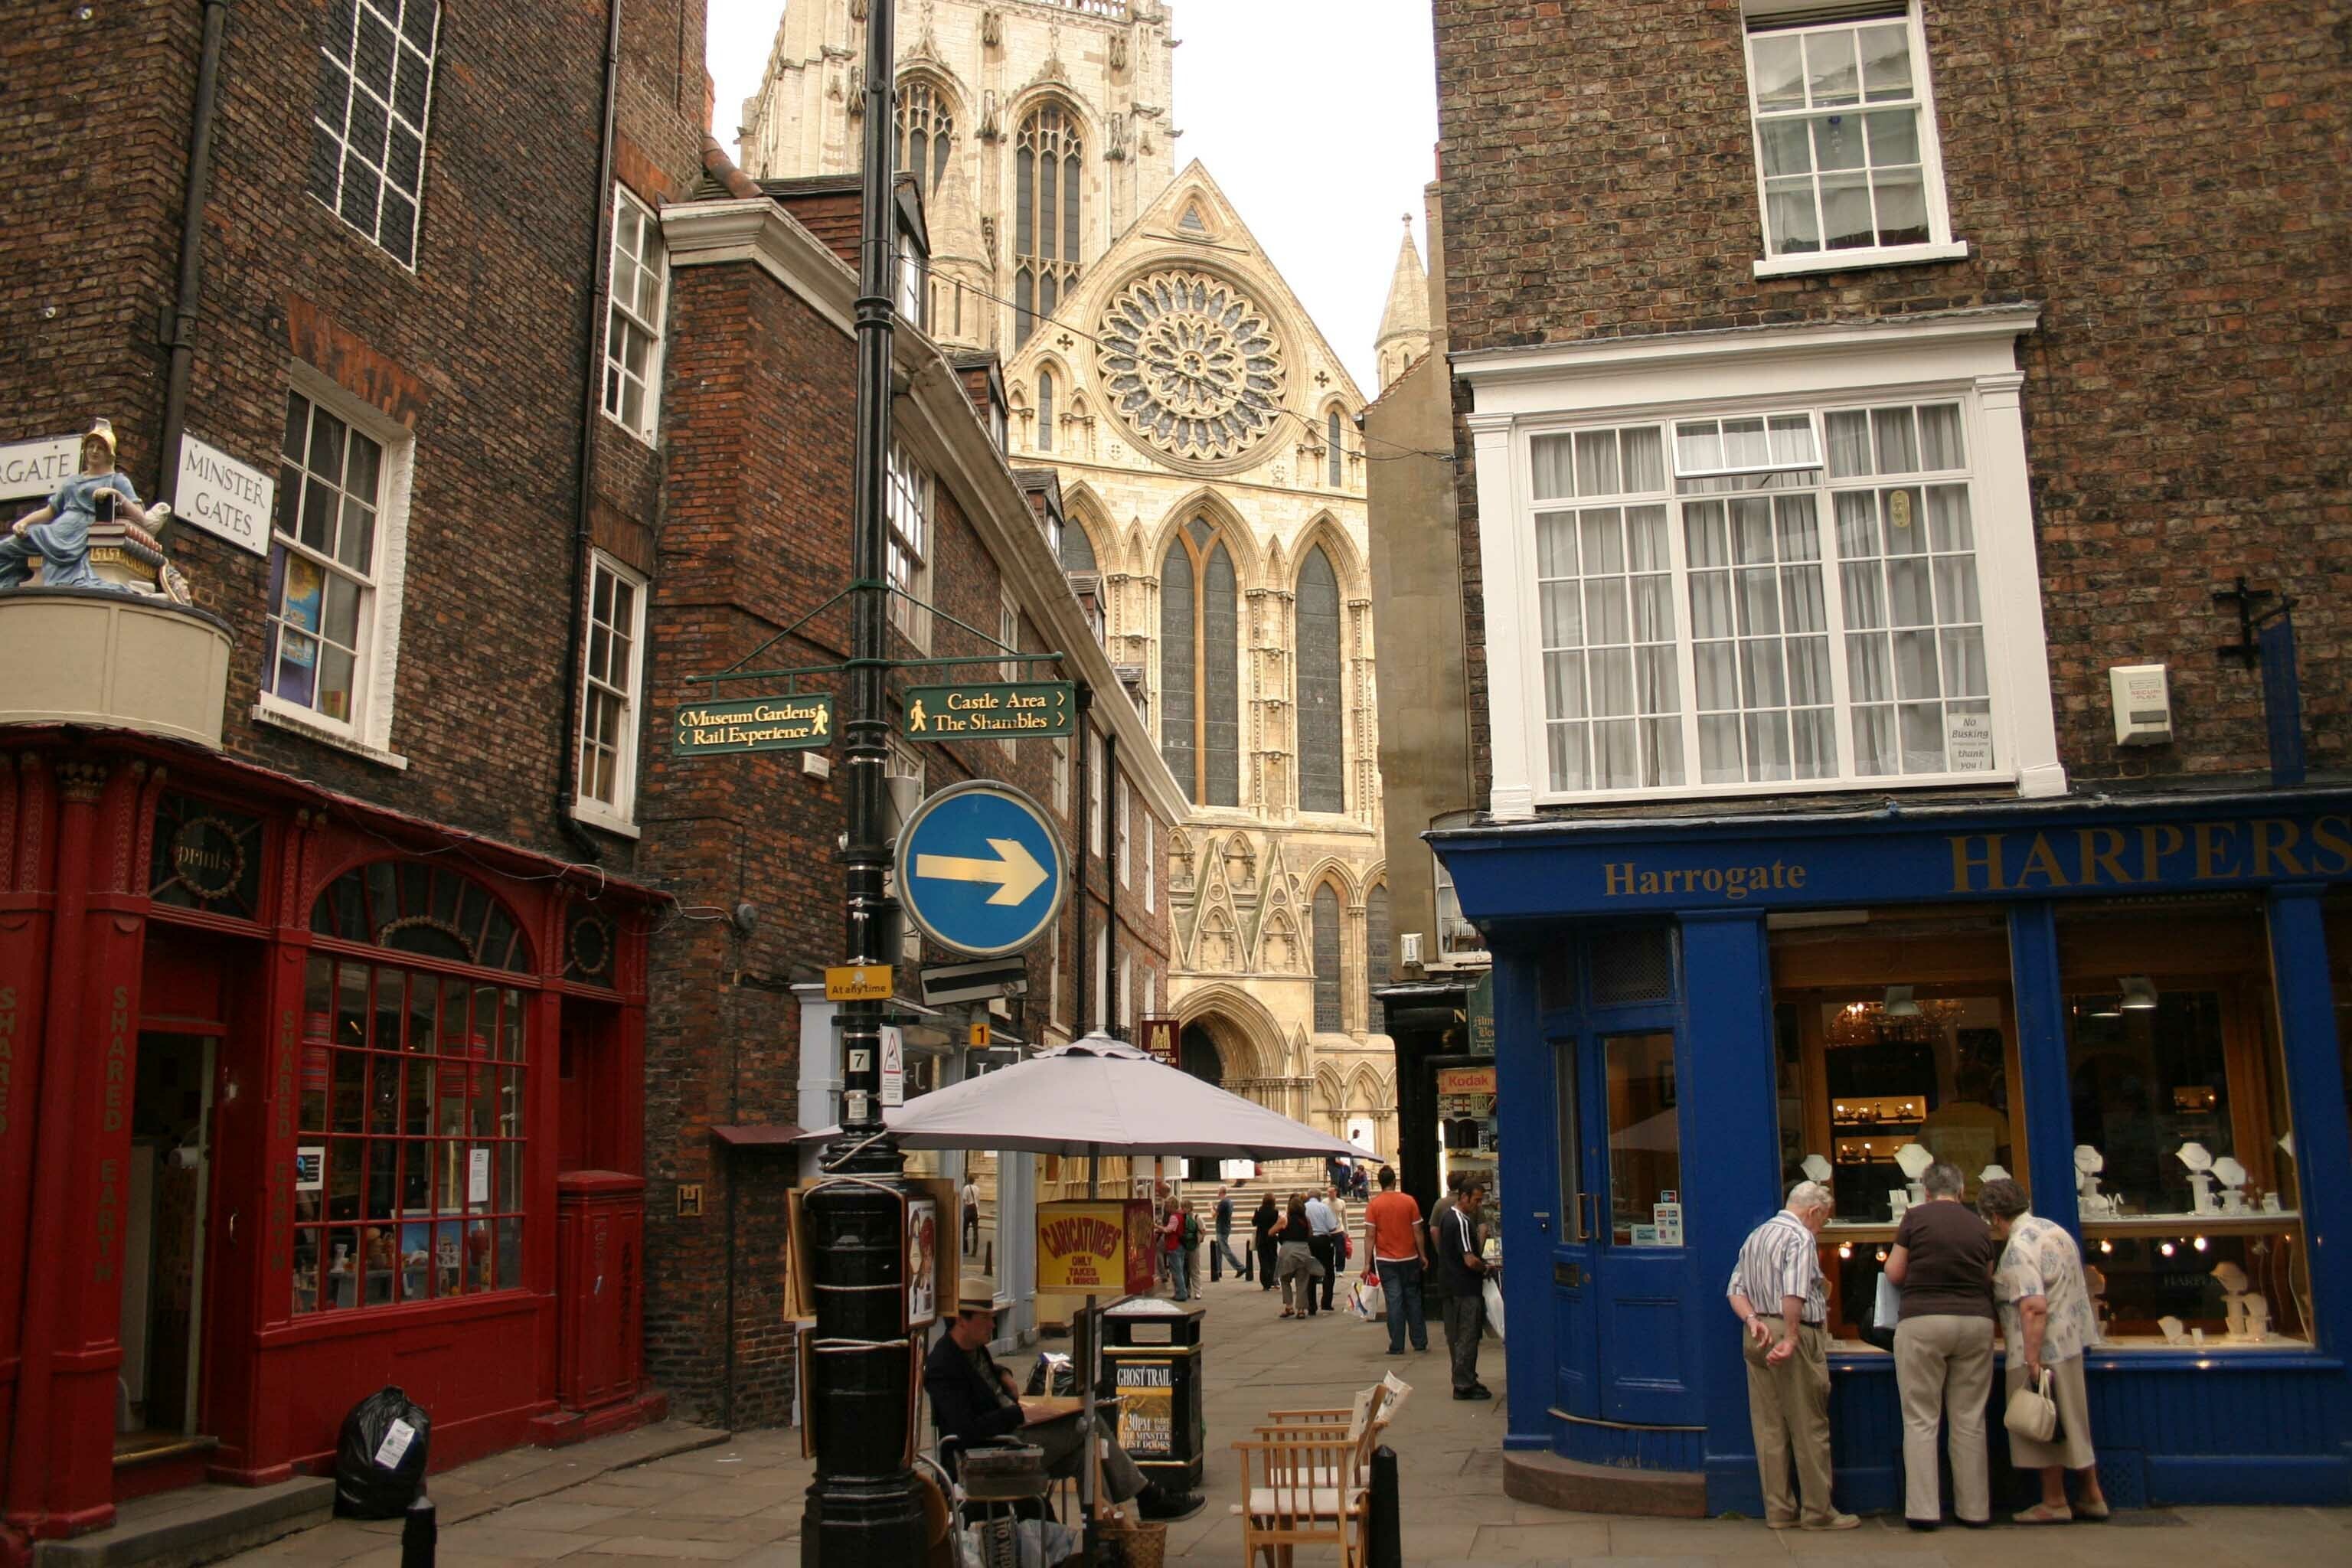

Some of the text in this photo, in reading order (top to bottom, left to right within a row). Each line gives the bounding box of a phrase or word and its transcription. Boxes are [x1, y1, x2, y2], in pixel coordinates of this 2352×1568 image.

[185, 449, 265, 509] MINSTER
[195, 492, 253, 537] GATES
[947, 692, 1047, 710] Castle Area
[688, 704, 816, 727] Museum Gardens
[933, 712, 1047, 731] The Shambles
[1963, 717, 1977, 727] No
[693, 727, 809, 746] Rail Experience
[1952, 729, 1989, 740] Busking
[1958, 750, 1984, 758] thank
[1945, 815, 2352, 893] HARPERS
[1603, 858, 1808, 900] Harrogate
[831, 985, 844, 995] At
[977, 1026, 985, 1044] 1
[854, 1054, 864, 1067] 7
[276, 1009, 295, 1139] SHARED
[1449, 1075, 1488, 1086] Kodak
[93, 986, 128, 1284] SHARED EARTH
[1040, 1217, 1122, 1259] CARICATURES
[1072, 1256, 1093, 1266] ONLY
[1068, 1267, 1096, 1276] TAKES
[1117, 1368, 1171, 1387] GHOST TRAIL
[1142, 1440, 1170, 1450] DOORS
